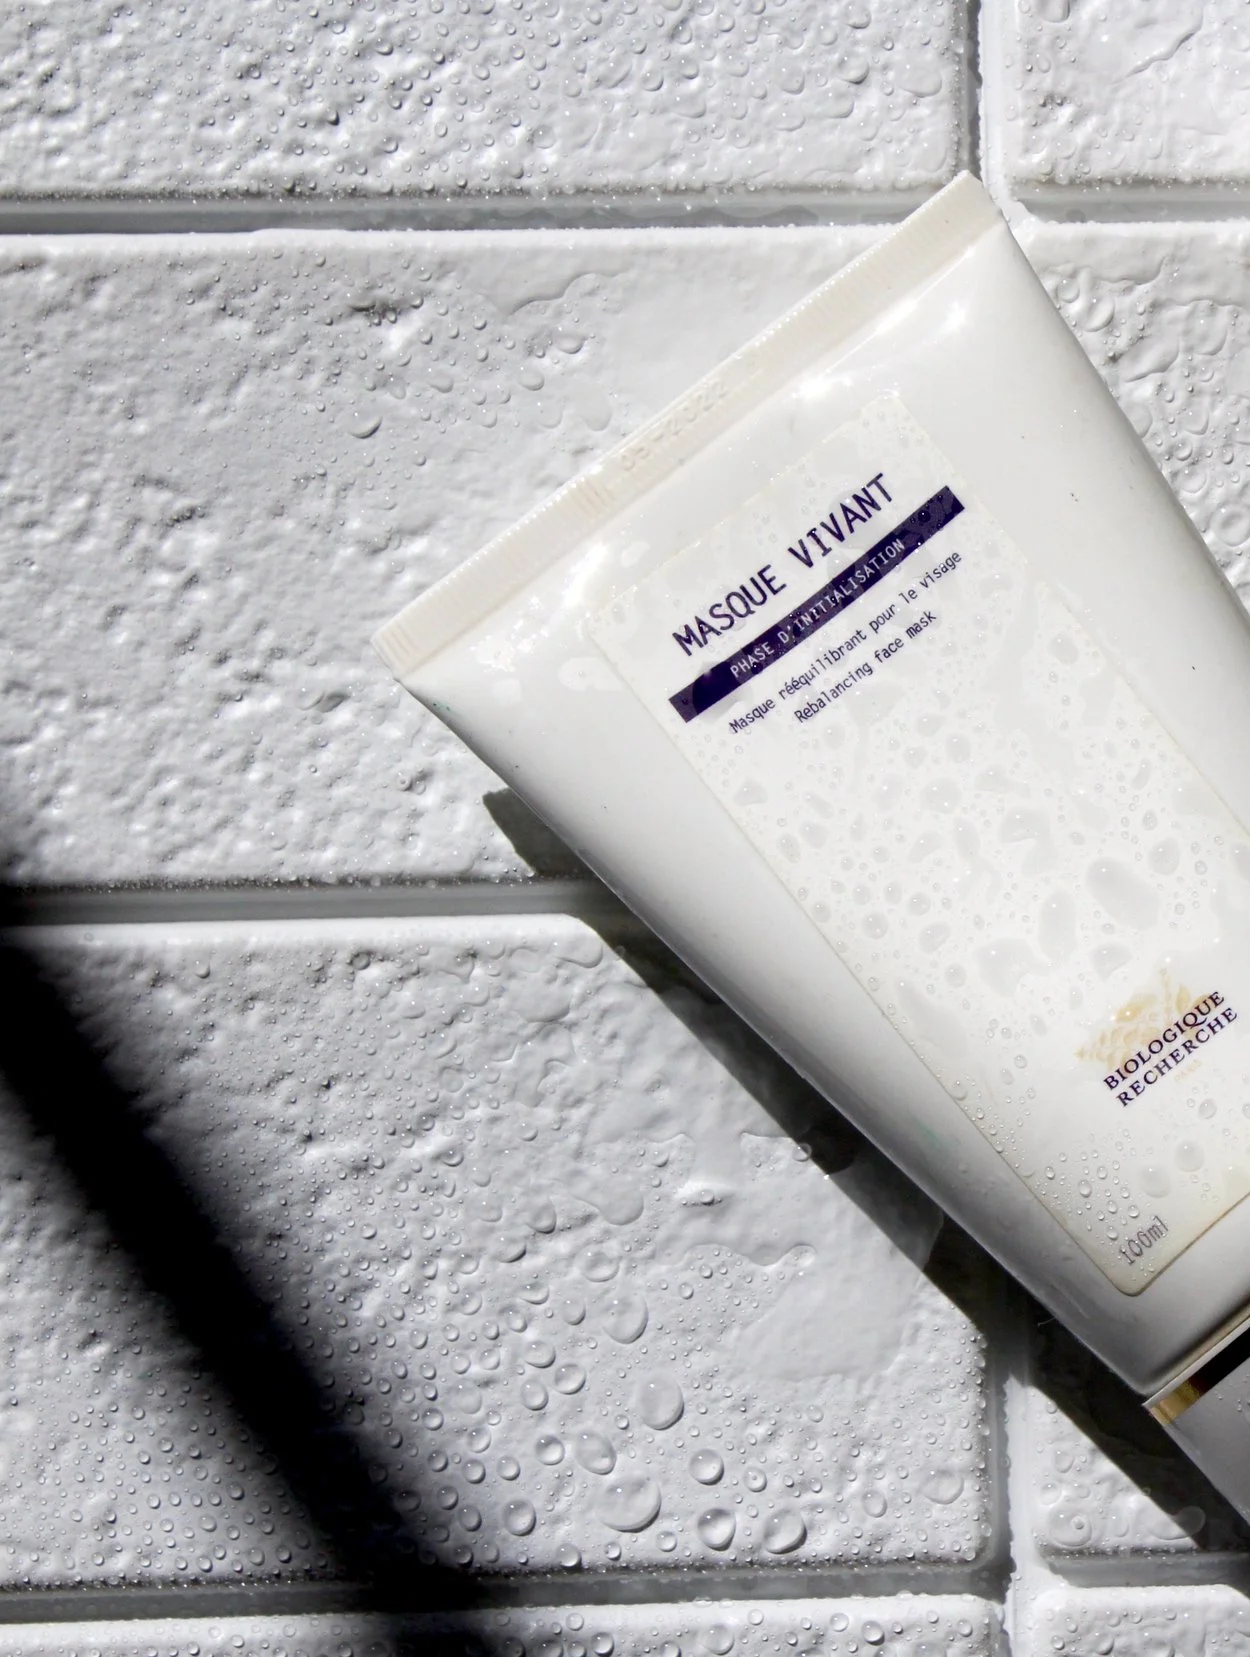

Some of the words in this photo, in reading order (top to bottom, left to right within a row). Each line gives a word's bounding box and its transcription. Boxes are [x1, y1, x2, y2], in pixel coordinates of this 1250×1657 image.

[672, 564, 787, 656] MASQUE
[787, 472, 893, 569] VIVANT
[730, 640, 775, 679] PHASE
[777, 539, 906, 643] D'INITIALISATION
[729, 699, 776, 733] Masque
[778, 628, 867, 700] rééquilibrant
[869, 606, 900, 636] pour
[900, 588, 918, 606] le
[920, 551, 962, 588] visage
[794, 661, 873, 723] Rebalancing
[875, 637, 904, 662] face
[906, 611, 937, 638] mask
[1103, 991, 1225, 1091] BIOLOGIQUE
[1116, 1007, 1238, 1107] RECHERCHE
[1118, 1215, 1169, 1266] 100ml
